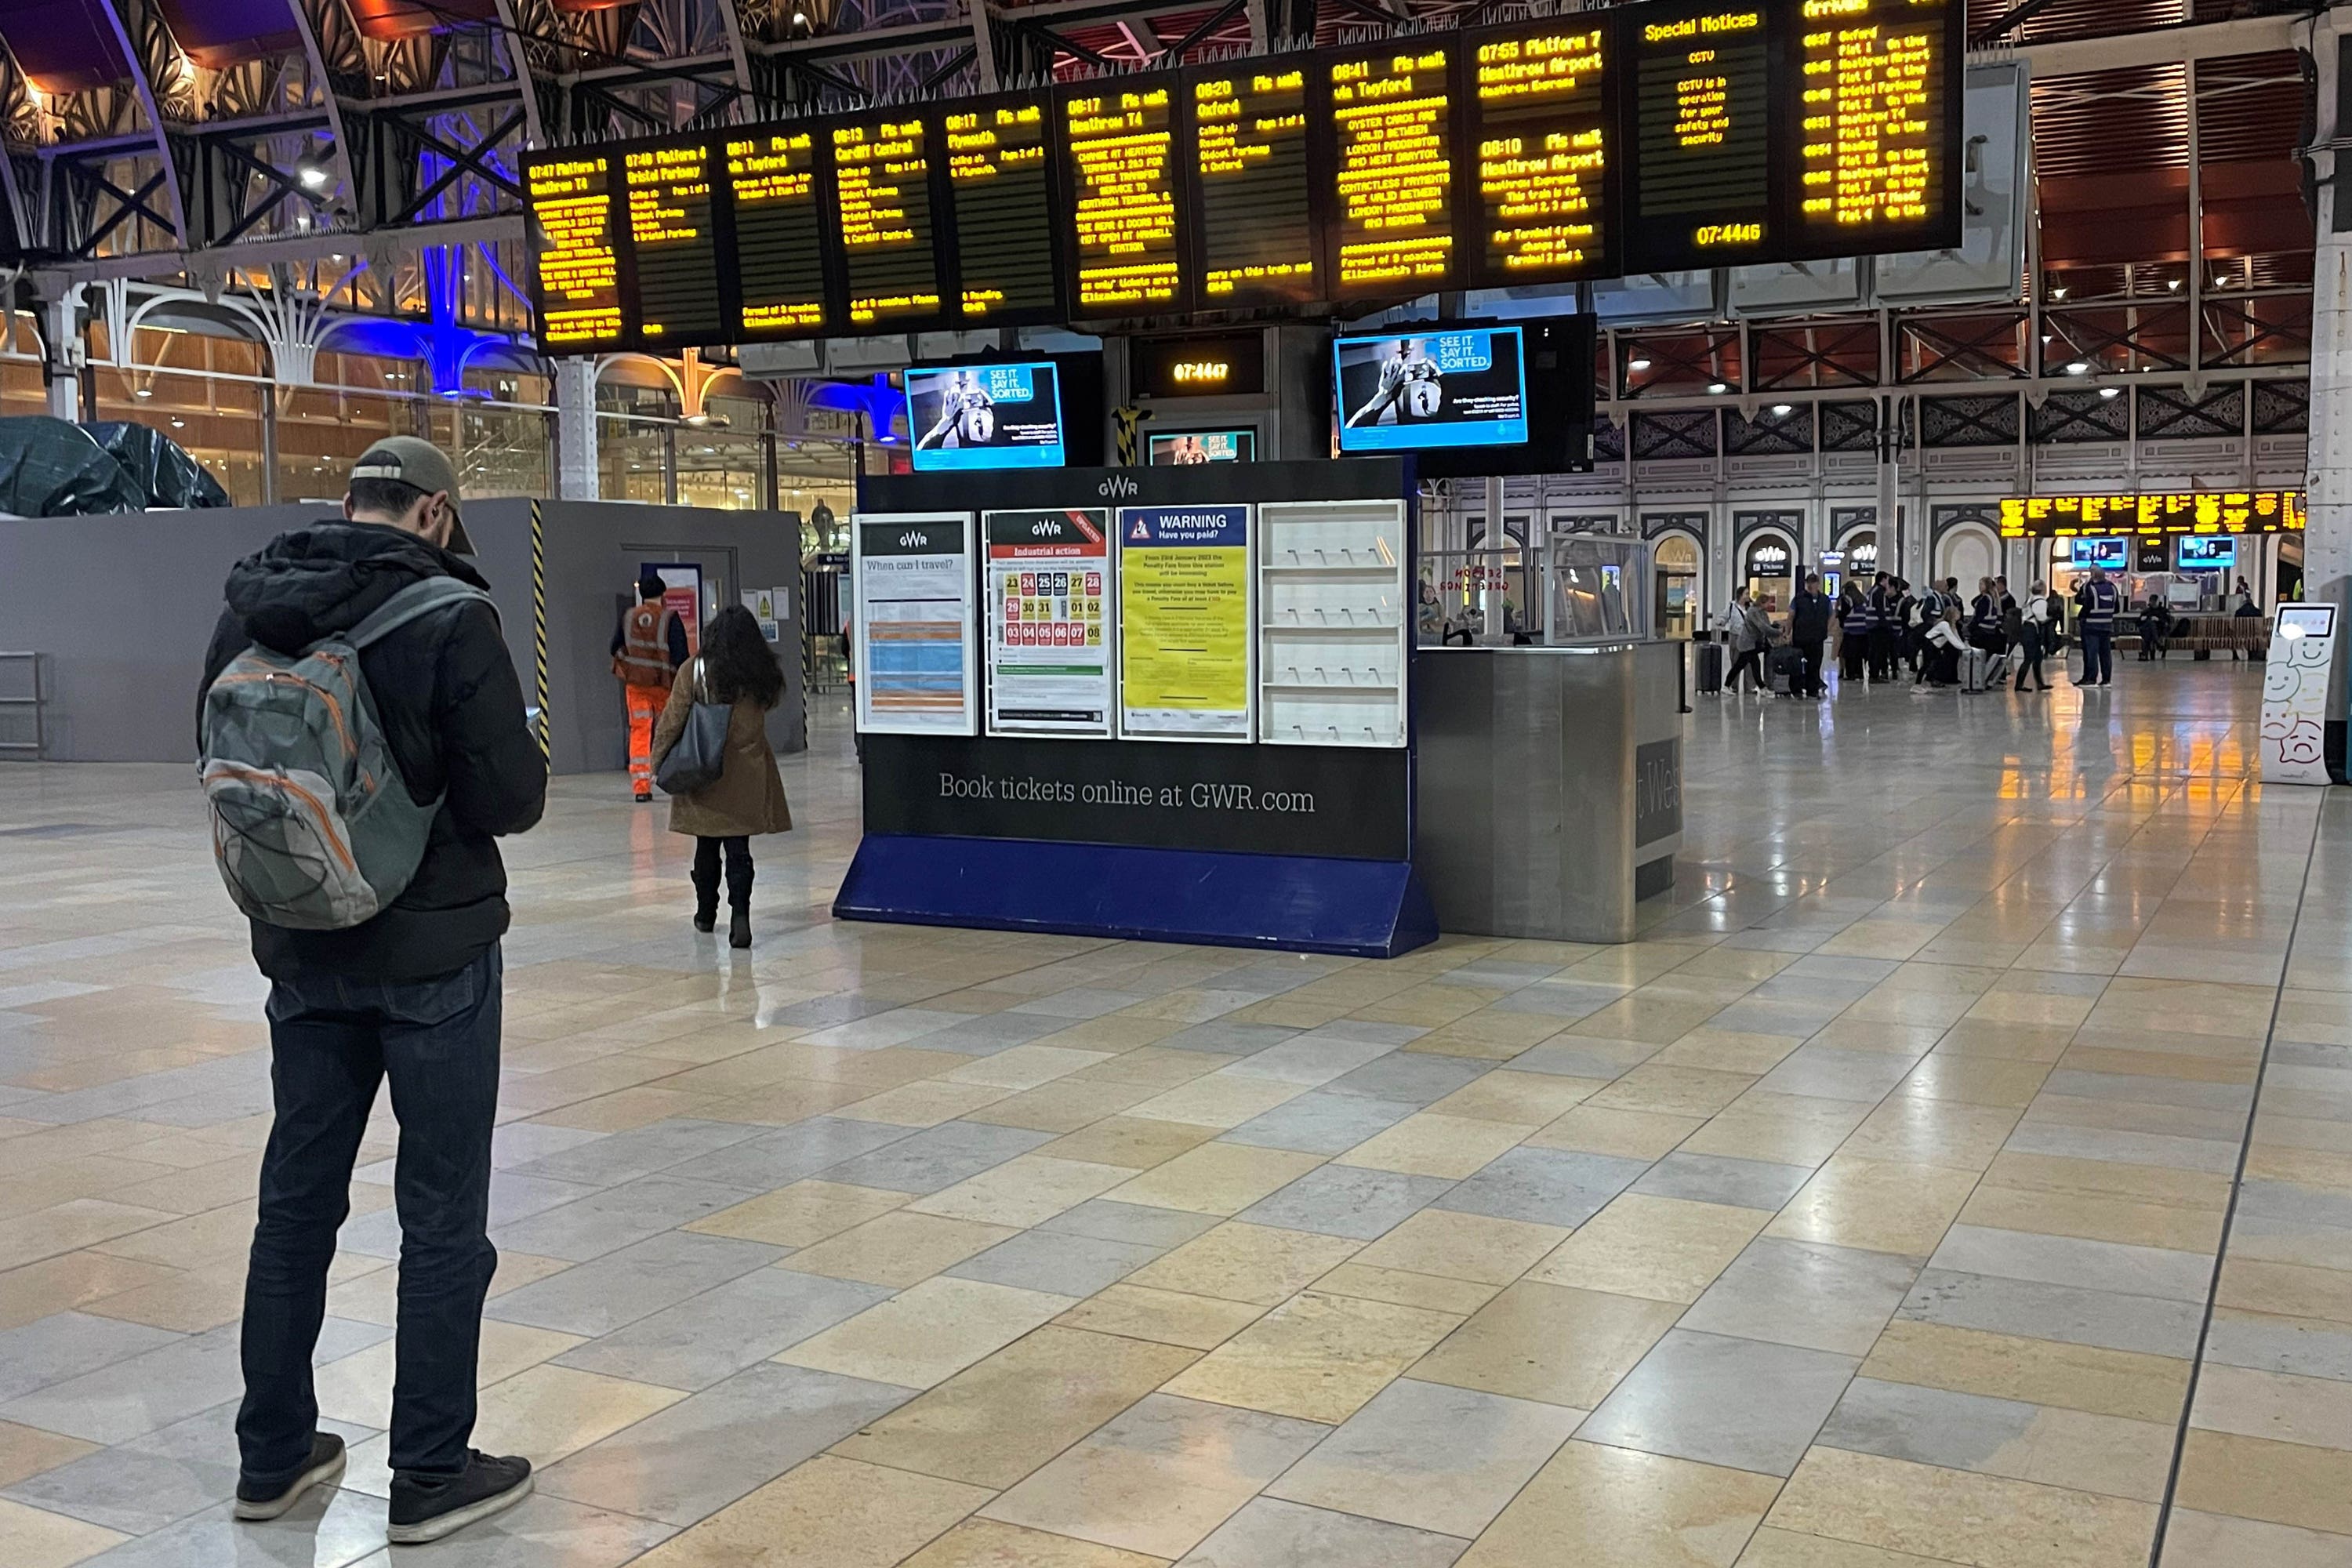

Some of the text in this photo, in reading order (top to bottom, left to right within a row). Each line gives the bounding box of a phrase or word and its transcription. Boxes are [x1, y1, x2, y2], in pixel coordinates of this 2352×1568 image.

[1645, 13, 1758, 41] Special Notices
[1479, 30, 1601, 63] 07:55 Platform 7
[1689, 49, 1715, 64] CCTV
[1333, 50, 1446, 80] 08:41 Pls wait
[1479, 52, 1602, 82] Heathrow Airport
[1254, 75, 1272, 91] Pls
[1276, 71, 1303, 88] wait
[1334, 76, 1411, 100] via Twyford
[1480, 77, 1575, 98] Heathrow Express
[1677, 76, 1726, 93] CCTV is in
[1068, 89, 1168, 114] 08:17 Pls wait
[1678, 91, 1726, 106] operation
[1197, 98, 1240, 118] Oxford
[1680, 105, 1723, 118] for your
[946, 105, 1040, 130] 08:17 Pls wait
[1069, 111, 1142, 134] Heathrow T4
[1348, 110, 1436, 130] OYSTER CARDS ARE
[1675, 116, 1730, 133] safety and
[881, 124, 898, 138] Pls
[900, 120, 923, 135] wait
[1356, 124, 1428, 142] VALID BETWEEN
[789, 132, 811, 148] wait
[948, 130, 995, 149] Plymouth
[1346, 135, 1440, 156] LONDON PADDINGTON
[1481, 128, 1602, 157] 08:10 Pls wait
[1681, 131, 1723, 146] security
[656, 149, 696, 164] Platform
[835, 139, 913, 162] Cardiff Central
[746, 154, 786, 171] Twyford
[1348, 157, 1367, 168] AND
[1369, 154, 1393, 165] WEST
[1482, 149, 1604, 177] Heathrow Airport
[556, 162, 594, 176] Platform
[627, 166, 700, 184] Bristol Parkway
[1339, 172, 1450, 194] CONTACTLESS PAYMENTS
[1483, 173, 1577, 193] Heathrow Express
[1349, 186, 1442, 205] ARE VALID BETWEEN
[1348, 198, 1442, 218] LONDON PADDINGTON
[1364, 217, 1383, 228] AND
[1341, 256, 1375, 267] Formed
[1377, 255, 1389, 264] of
[1341, 263, 1445, 280] Elizabeth line
[1439, 335, 1474, 347] SEE IT.
[1440, 347, 1475, 358] SAY IT.
[1441, 356, 1490, 369] SORTED.
[990, 368, 1018, 379] SEE IT.
[991, 379, 1020, 390] SAY IT.
[992, 388, 1031, 399] SORTED.
[1098, 474, 1138, 499] GWR
[1032, 518, 1062, 537] GWR
[1076, 514, 1100, 543] UPDATED
[1159, 514, 1227, 529] WARNING
[899, 530, 927, 548] GWR
[1159, 529, 1218, 540] Have you paid?
[1014, 546, 1081, 556] Industrial action
[867, 561, 894, 571] When
[921, 559, 953, 570] travel?
[1007, 578, 1018, 588] 23
[1022, 578, 1034, 588] 24
[1038, 578, 1051, 588] 25
[1054, 578, 1066, 588] 26
[1071, 578, 1083, 588] 27
[1087, 578, 1099, 588] 28
[1007, 602, 1018, 612] 29
[1022, 602, 1034, 612] 30
[1038, 602, 1050, 612] 31
[1071, 602, 1083, 612] 01
[1087, 602, 1099, 612] 02
[1007, 627, 1019, 637] 03
[1023, 627, 1035, 637] 04
[1039, 627, 1051, 637] 05
[1055, 627, 1066, 637] 06
[1071, 627, 1083, 637] 07
[1087, 627, 1099, 637] 08
[939, 772, 1316, 812] Book tickets online at GWR.com
